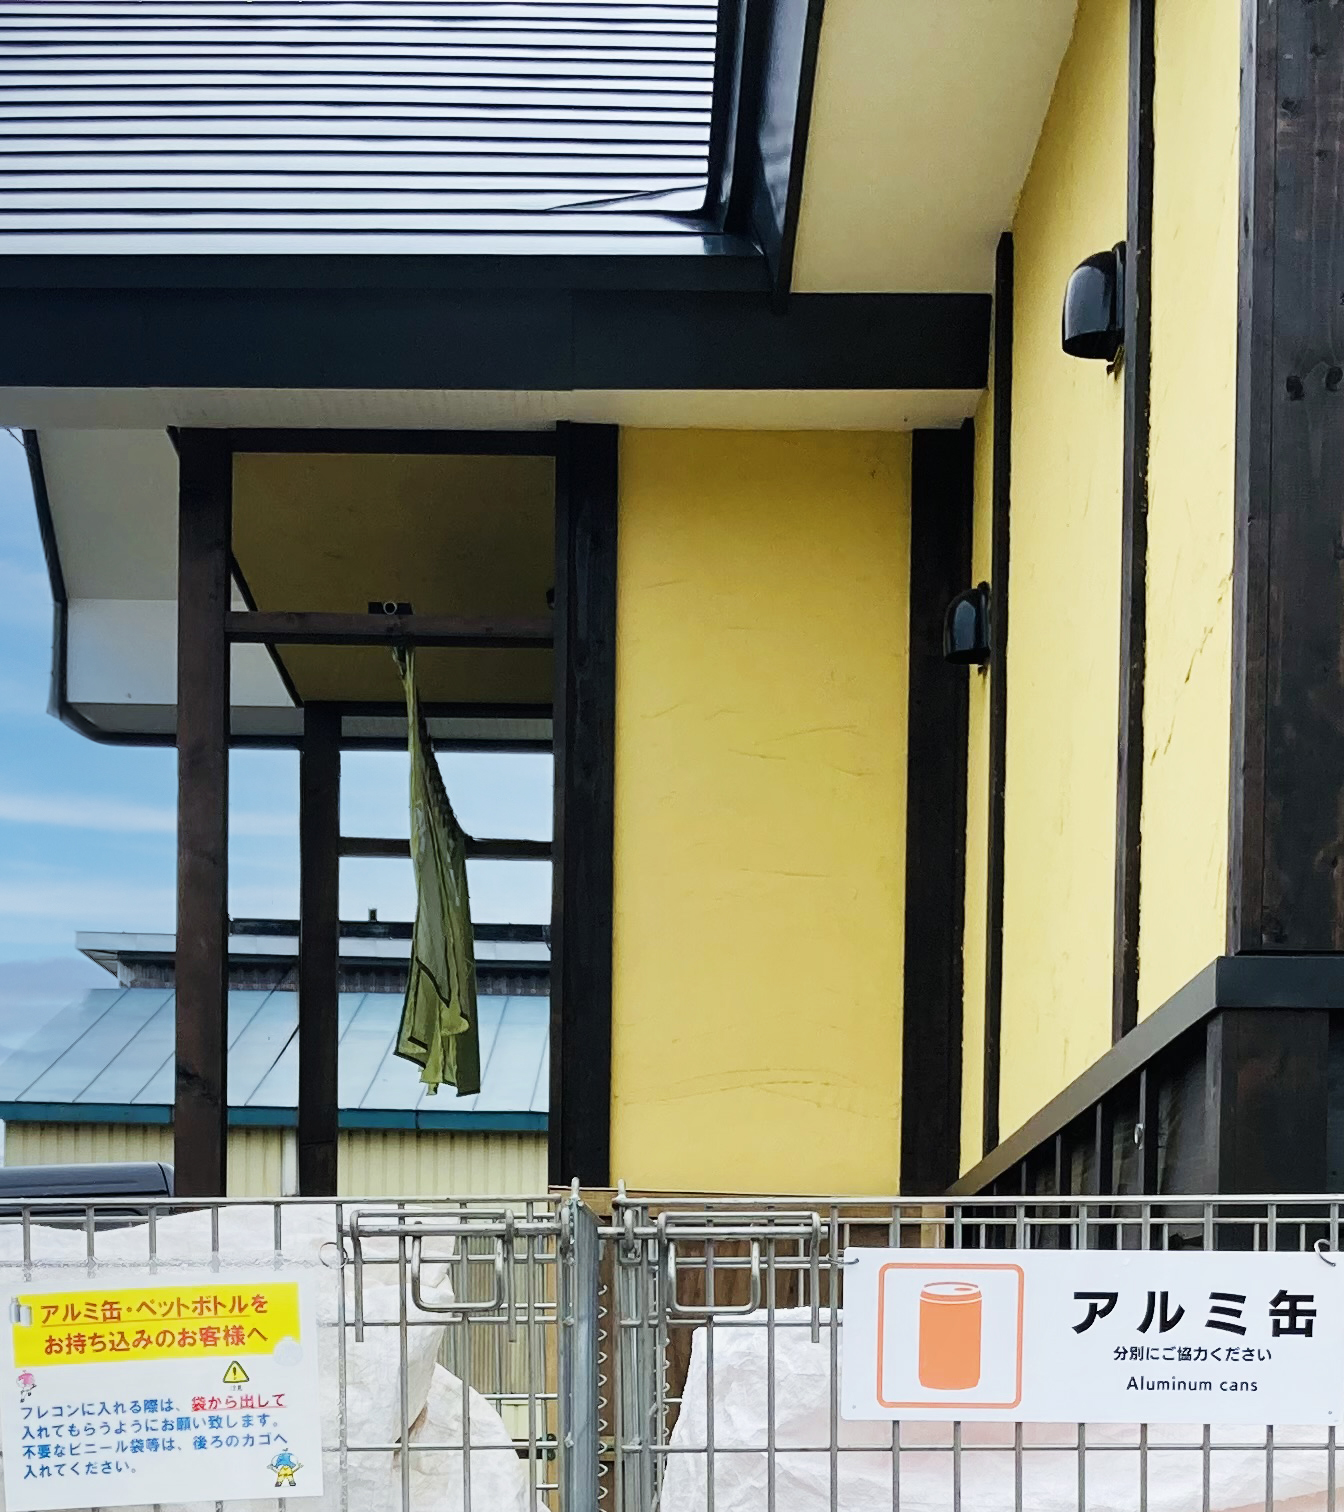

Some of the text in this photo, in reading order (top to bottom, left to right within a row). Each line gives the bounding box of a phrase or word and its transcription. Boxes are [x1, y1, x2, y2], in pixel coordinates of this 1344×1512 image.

[40, 1293, 269, 1325] アルミ缶・ペットボトルを
[1072, 1290, 1317, 1338] アルミ缶
[44, 1325, 268, 1355] お持ち込みのお客様へ
[1113, 1346, 1272, 1362] 分別にご協力ください
[1126, 1376, 1258, 1392] Aluminum cans
[20, 1393, 286, 1420] フレコンに入れる際は、袋から出して
[21, 1414, 280, 1440] 入れてもらうようにお願い致します。
[22, 1433, 287, 1459] 不要なビニール袋等は、後ろのカゴへ
[23, 1460, 136, 1479] 入れてください。
